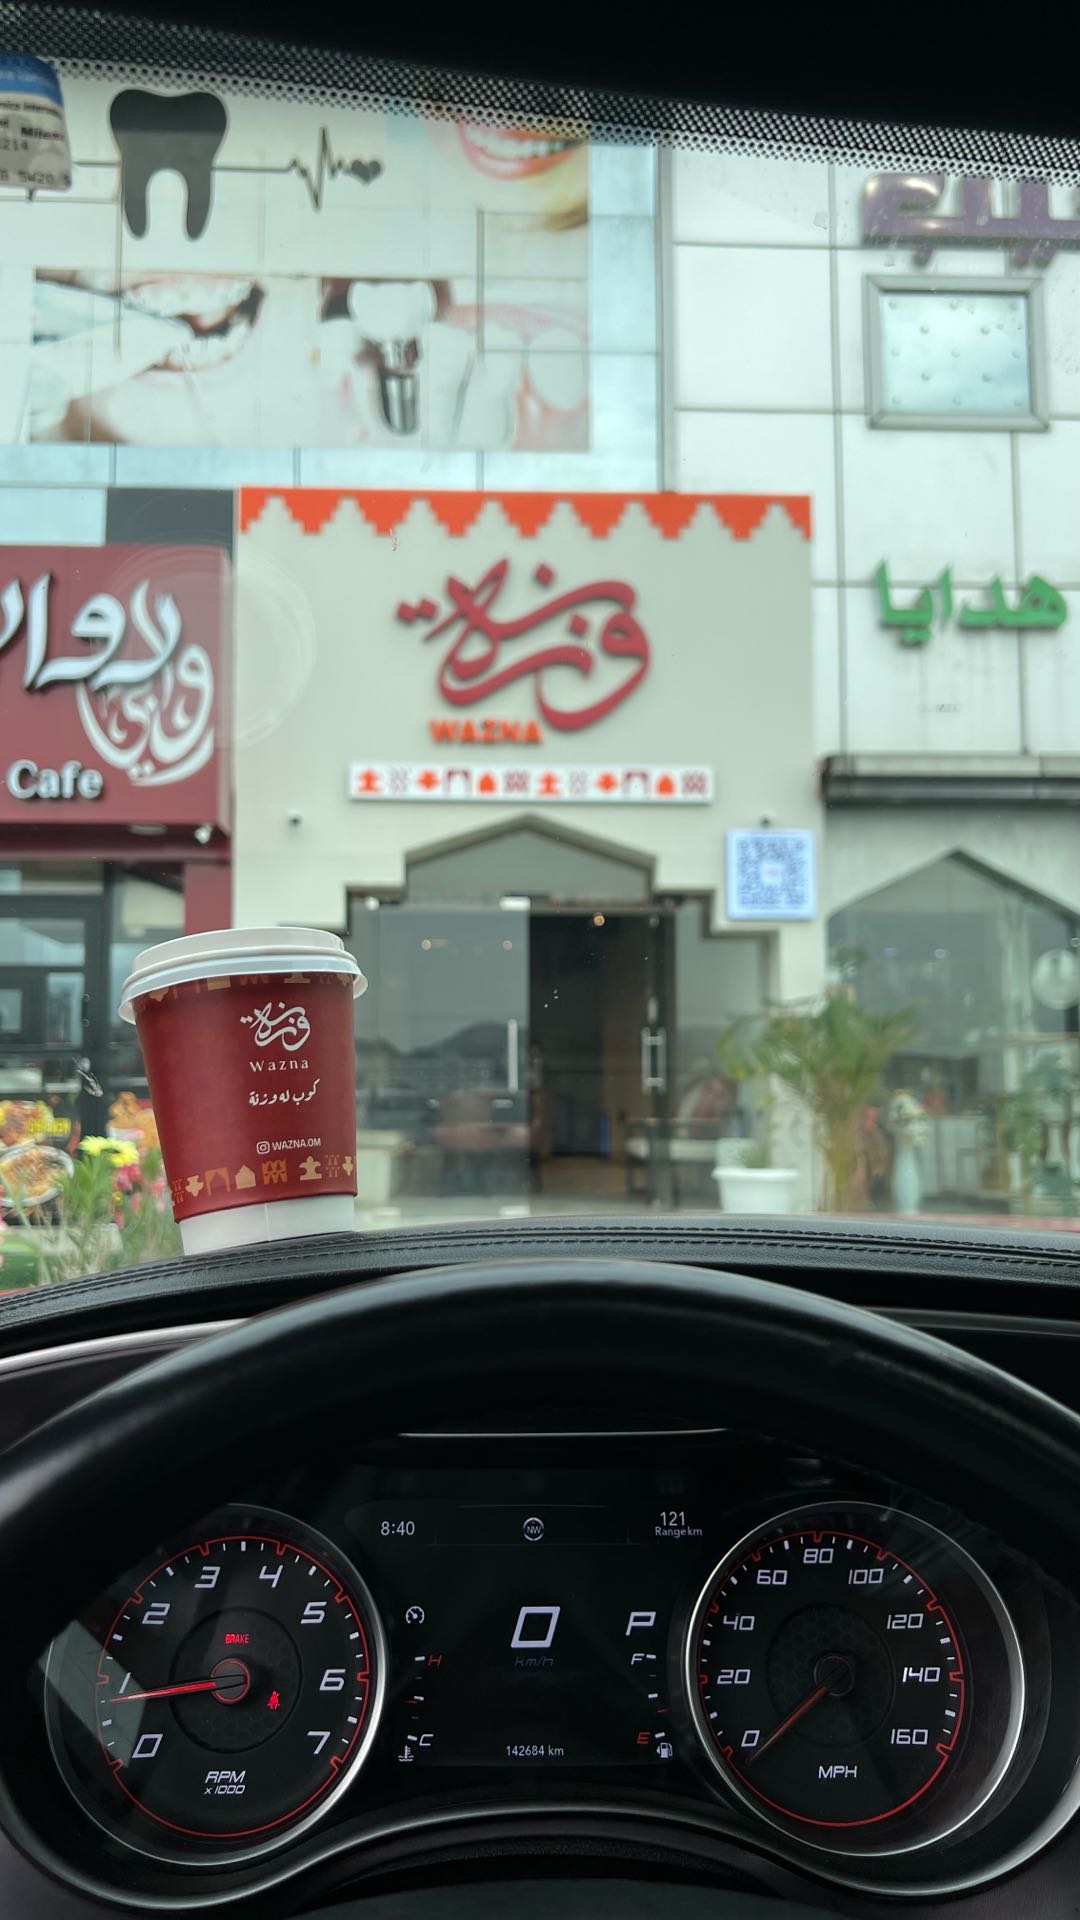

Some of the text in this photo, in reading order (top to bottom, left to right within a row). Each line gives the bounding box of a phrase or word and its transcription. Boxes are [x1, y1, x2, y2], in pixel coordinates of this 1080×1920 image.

[876, 558, 1067, 645] هدايا
[429, 720, 542, 744] WAZNA
[7, 759, 103, 800] Cafe
[249, 1060, 310, 1073] Wazna
[293, 1078, 320, 1106] كوب
[660, 1511, 686, 1526] 121
[380, 1520, 416, 1536] 8:40
[526, 1525, 542, 1535] NW
[655, 1526, 687, 1539] Range
[803, 1548, 834, 1564] 80
[195, 1566, 221, 1589] 3
[259, 1565, 284, 1589] 4
[756, 1569, 788, 1586] 60
[848, 1568, 884, 1585] 100
[142, 1602, 171, 1625] 2
[300, 1601, 327, 1624] 5
[887, 1612, 924, 1630] 120
[510, 1606, 561, 1648] 0
[625, 1611, 657, 1636] P
[723, 1614, 755, 1631] 40
[224, 1633, 250, 1645] BRAKE
[427, 1654, 442, 1667] H
[630, 1652, 645, 1665] F
[319, 1668, 346, 1691] 6
[716, 1668, 751, 1685] 20
[902, 1666, 941, 1683] 140
[306, 1730, 331, 1755] 7
[418, 1733, 434, 1747] C
[636, 1731, 650, 1745] E
[740, 1729, 760, 1748] 0
[890, 1728, 929, 1745] 160
[131, 1733, 163, 1759] 0
[505, 1745, 565, 1757] 142684 km
[204, 1770, 247, 1784] RPM
[818, 1765, 858, 1779] MPH
